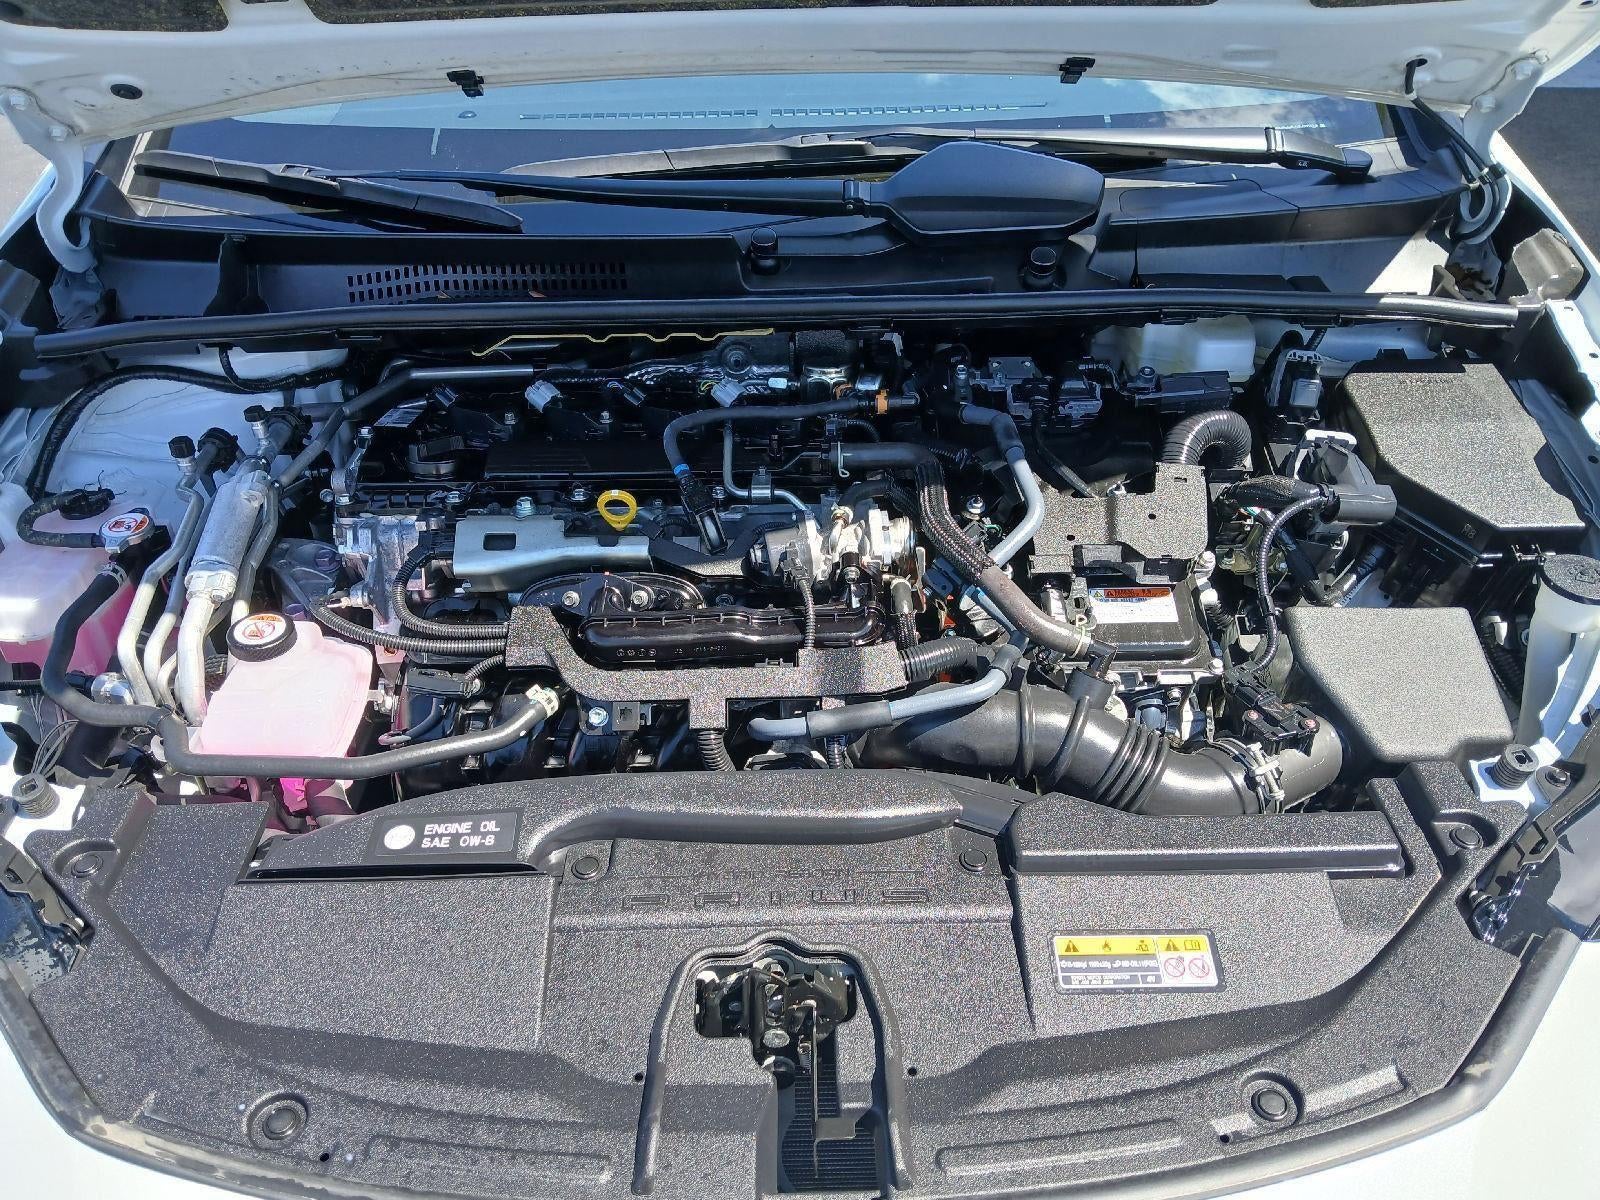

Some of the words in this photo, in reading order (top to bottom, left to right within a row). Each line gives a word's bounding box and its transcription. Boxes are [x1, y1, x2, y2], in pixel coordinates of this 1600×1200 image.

[424, 822, 473, 836] ENGINE
[480, 820, 500, 833] OIL
[421, 837, 451, 848] SAE
